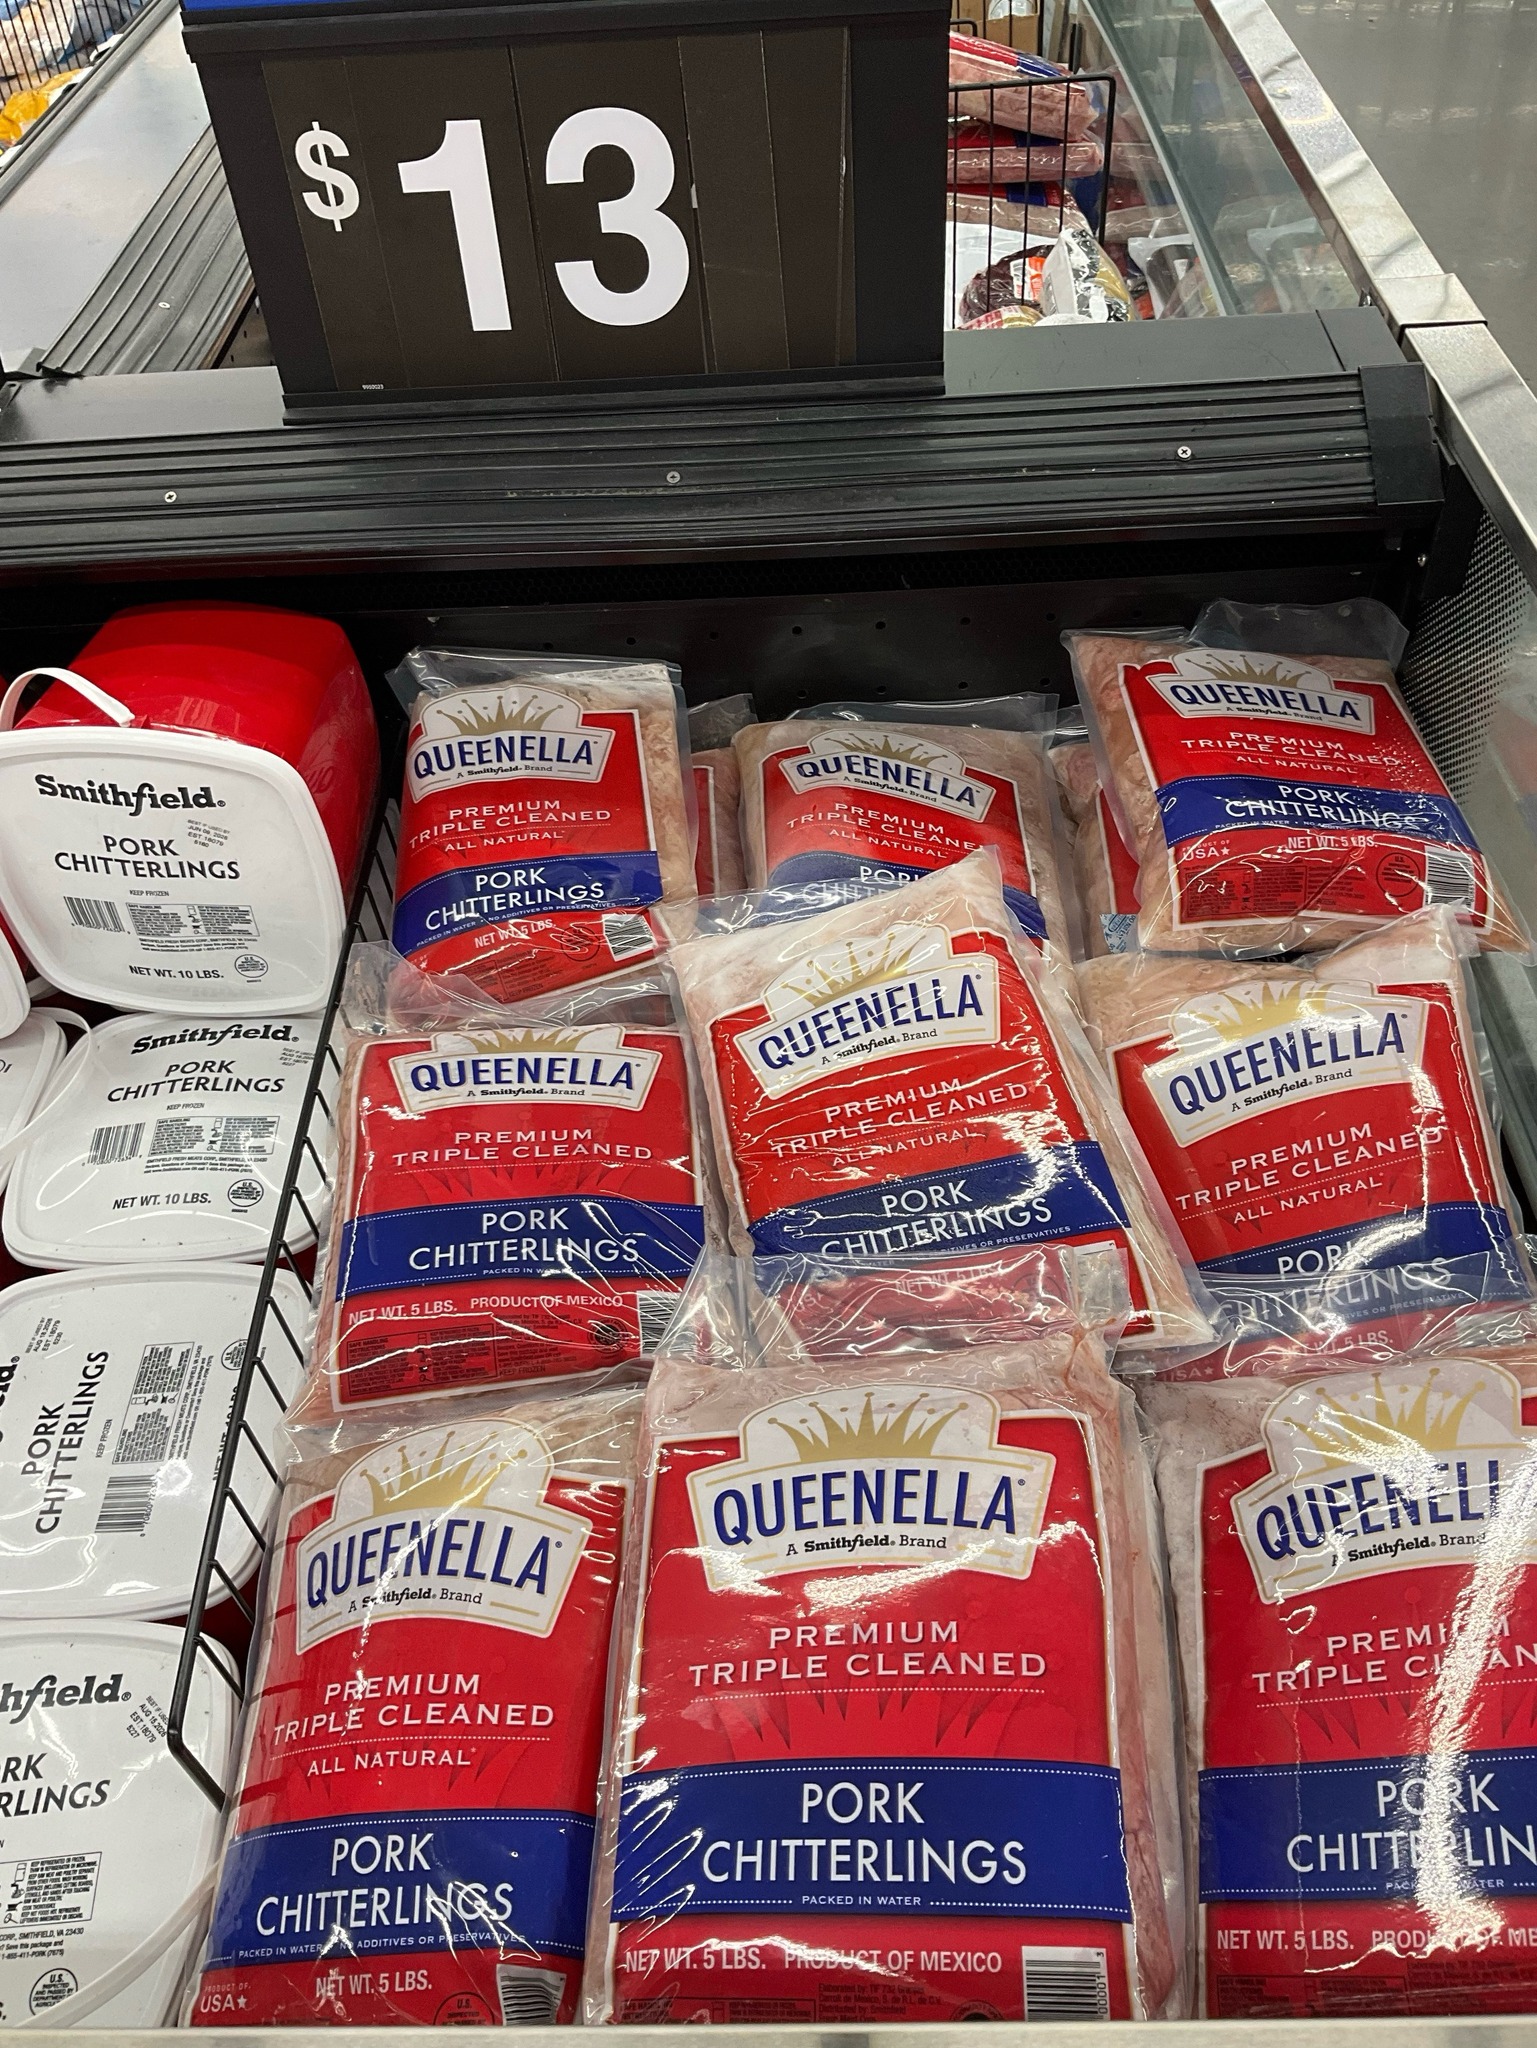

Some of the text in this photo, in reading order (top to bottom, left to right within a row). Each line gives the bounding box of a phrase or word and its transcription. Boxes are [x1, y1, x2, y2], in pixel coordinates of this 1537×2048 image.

[1169, 685, 1361, 722] QUEENELLA
[1294, 712, 1323, 721] Brand
[1181, 739, 1401, 767] TRIPLE CLEANED
[1229, 731, 1344, 751] PREMIUM
[413, 735, 594, 779] QUEENELLA
[524, 764, 553, 773] Brand
[1235, 755, 1357, 774] ALL NATURAL
[796, 754, 977, 808] QUEENELLA
[1278, 785, 1353, 805] PORK
[449, 800, 562, 820] PREMIUM
[909, 790, 937, 802] Brand
[408, 809, 612, 850] TRIPLE CLEANED
[786, 811, 872, 830] TRIPLE
[834, 802, 945, 835] PREMIUM
[1225, 799, 1421, 831] CHITTERLINGS
[102, 835, 180, 857] PORK
[444, 831, 563, 852] ALL NATURAL
[829, 828, 946, 859] ALL NATURAL
[1183, 848, 1219, 861] USA
[1288, 835, 1350, 850] NET WT. 5
[54, 851, 241, 880] CHITTERLINGS
[474, 866, 548, 891] PORK
[425, 882, 606, 932] CHITTERLINGS
[416, 933, 443, 947] PACKED
[452, 921, 477, 933] WATER
[488, 914, 500, 922] NO
[501, 908, 541, 920] ADDITIVES
[474, 919, 557, 949] NET 5 LBS.
[129, 965, 224, 979] NET WT. 10 LBS.
[757, 973, 984, 1069] QUEENELLA
[820, 1028, 938, 1066] A Brand
[164, 1060, 236, 1077] PORK
[410, 1057, 635, 1092] QUEENELLA
[1169, 1012, 1405, 1116] QUEENELLA
[107, 1078, 286, 1102] CHITTERLINGS
[467, 1087, 585, 1097] A Brand
[824, 1077, 963, 1123] PREMIUM
[1231, 1068, 1353, 1113] A Smithfield Brand
[770, 1082, 1030, 1160] TRIPLE CLEANED
[453, 1128, 594, 1145] PREMIUM
[832, 1129, 973, 1167] ALL NATURAL
[1230, 1122, 1373, 1176] PREMIUM
[392, 1142, 653, 1167] TRIPLE CLEANED
[1175, 1128, 1444, 1212] TRIPLE CLEANED
[112, 1192, 212, 1209] NET WT. 10 LBS.
[881, 1178, 973, 1219] PORK
[1232, 1176, 1382, 1225] ALL NATURAL
[480, 1206, 570, 1234] PORK
[820, 1198, 1053, 1263] CHITTERLINGS
[980, 1224, 1071, 1248] OR PRESERVATIVES
[408, 1238, 640, 1271] CHITTERLINGS
[482, 1267, 521, 1275] PACKED
[348, 1294, 624, 1326] NET WT. 5 LBS. PRODUCT OF MEXICO
[21, 1402, 65, 1476] PORK
[35, 1351, 110, 1535] CHITTERLINGS
[713, 1468, 1017, 1547] QUEENELLA
[785, 1534, 948, 1556] A Smithfield Brand
[1347, 1537, 1431, 1562] Smithfield
[307, 1519, 548, 1608] QUEENELLA
[347, 1589, 483, 1613] A Brand
[768, 1620, 960, 1650] PREMIUM
[688, 1652, 1047, 1688] TRIPLE CLEANED
[1252, 1659, 1388, 1694] TRIPLE
[324, 1673, 481, 1705] PREMIUM
[140, 1724, 157, 1743] 18079
[273, 1703, 555, 1746] TRIPLE CLEANED
[307, 1748, 471, 1777] ALL NATURAL
[800, 1782, 926, 1825] PORK
[331, 1832, 435, 1876] PORK
[702, 1837, 1028, 1885] CHITTERLINGS
[256, 1882, 514, 1936] CHITTERLINGS
[801, 1895, 921, 1906] PACKED IN WATER
[238, 1933, 527, 1959] PACKED IN WATER ADDITIVES OR PRESERVATIVES
[1217, 1930, 1354, 1950] NET WT. 5 LBS.
[625, 1948, 1003, 1974] NET WT. 5 LBS. PRODUCT OF MEXICO
[50, 1974, 65, 1983] U.S.
[315, 1969, 433, 1998] NET WT. 5 LBS.
[200, 1994, 236, 2013] USA
[457, 1998, 472, 2009] U.S.
